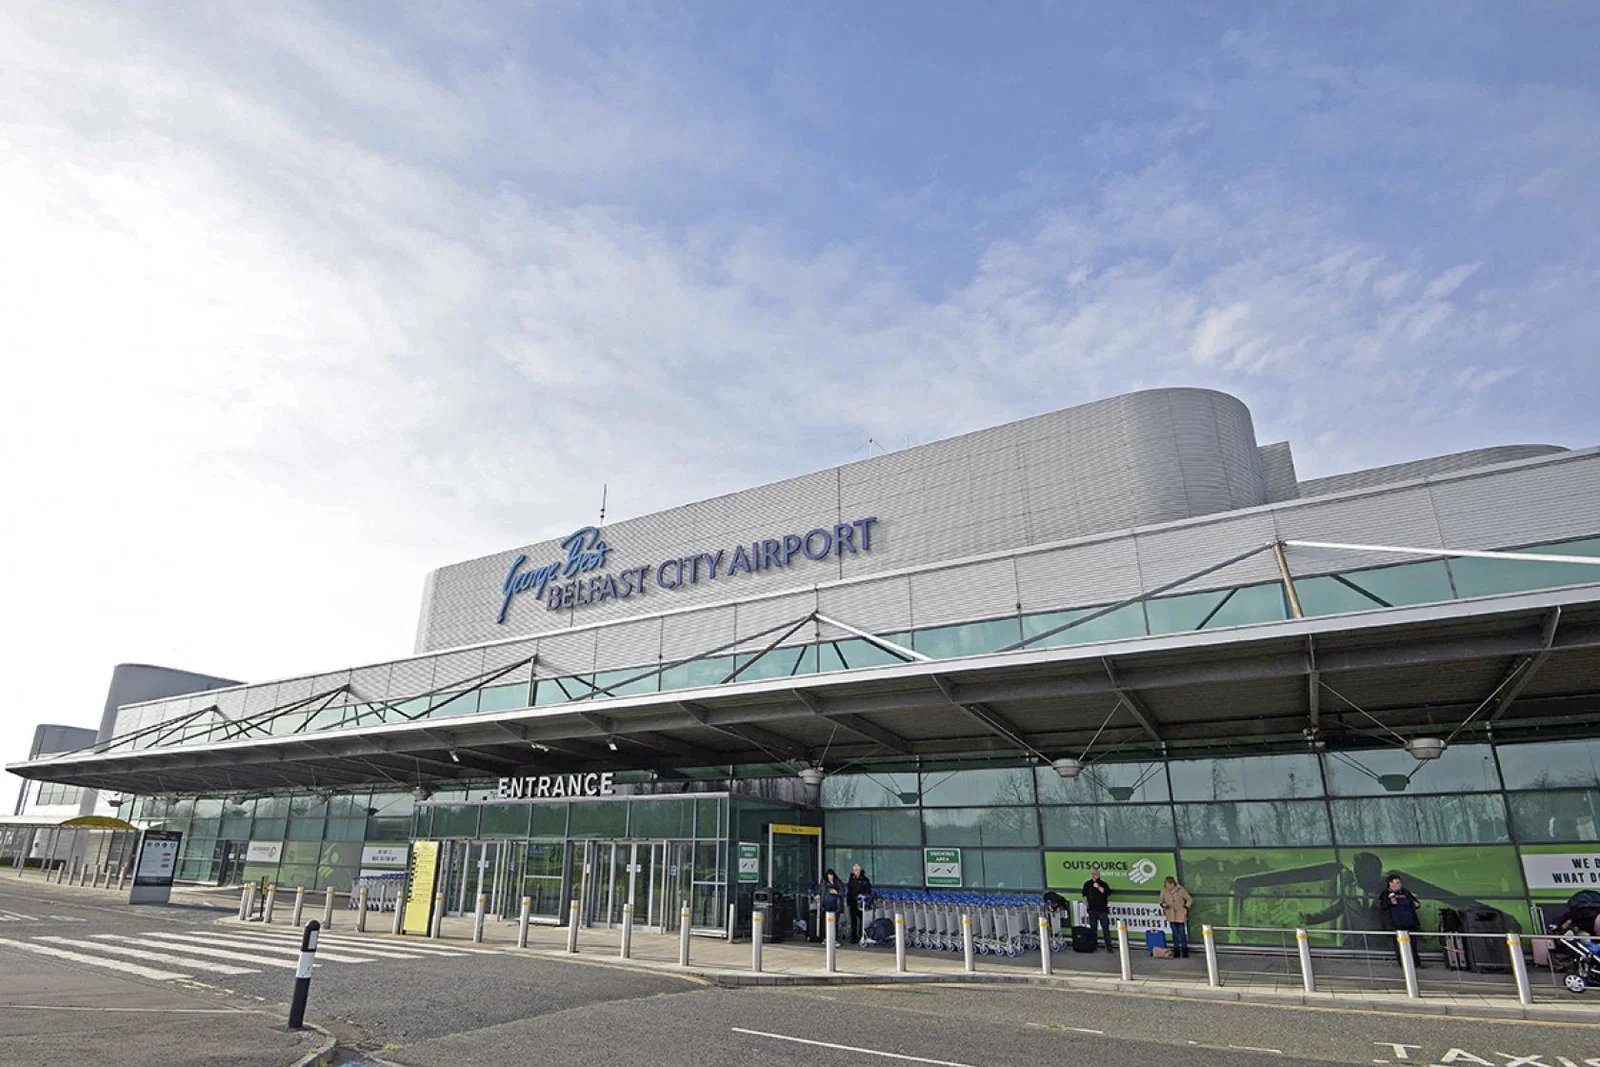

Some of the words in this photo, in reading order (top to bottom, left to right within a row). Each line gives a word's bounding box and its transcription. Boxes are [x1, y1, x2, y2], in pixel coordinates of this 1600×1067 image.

[547, 564, 650, 611] BELFAST
[657, 549, 725, 590] CITY
[728, 516, 878, 576] AIRPORT
[497, 554, 561, 624] George
[561, 526, 613, 579] Best
[498, 772, 614, 798] ENTRANCE
[1062, 860, 1128, 871] OUTSOURCE
[1571, 857, 1590, 869] WE
[1551, 872, 1584, 884] WHAT
[1107, 906, 1151, 916] ECHNOLOGY
